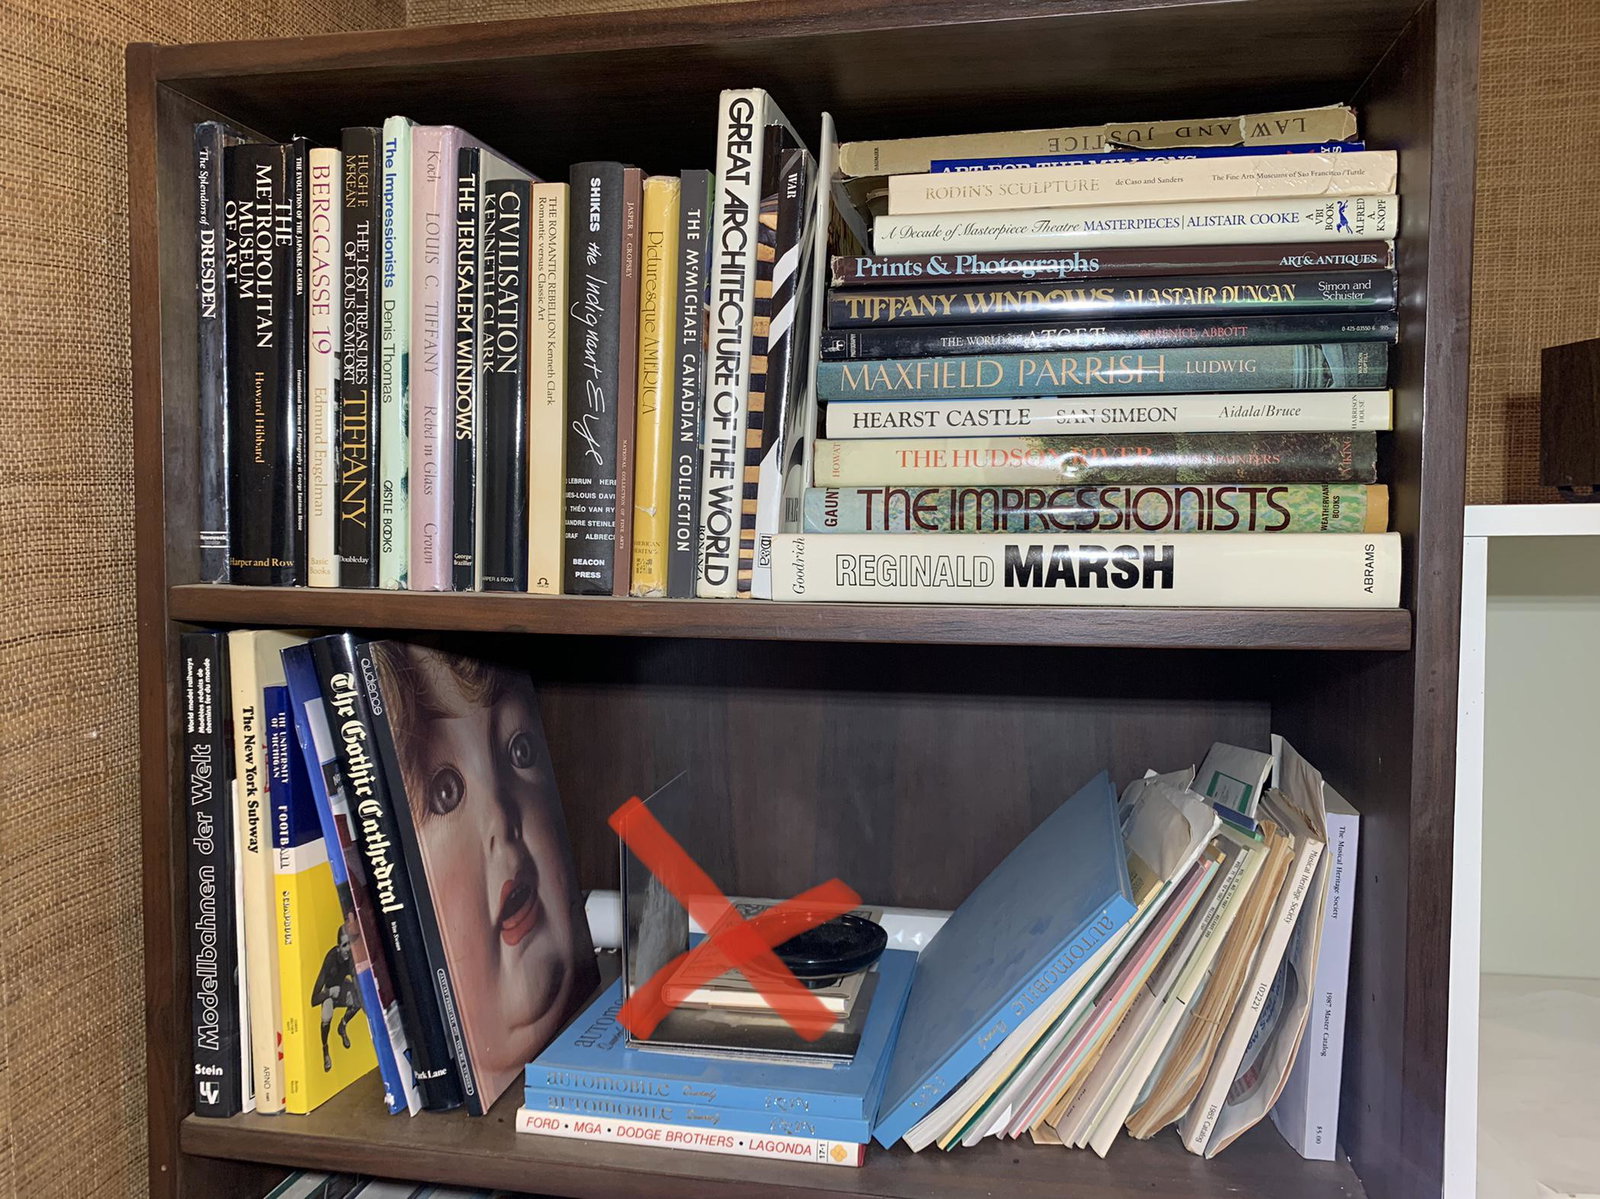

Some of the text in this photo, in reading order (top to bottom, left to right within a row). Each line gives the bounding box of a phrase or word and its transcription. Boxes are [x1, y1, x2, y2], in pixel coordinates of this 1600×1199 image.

[1250, 117, 1306, 138] LAW
[358, 154, 368, 190] HUGH
[787, 173, 798, 199] WAR
[1000, 179, 1100, 196] SCULPTURE
[1158, 176, 1183, 184] Sanders
[1257, 171, 1287, 179] Museums
[198, 150, 216, 319] The Splendors of DRESDEN
[275, 199, 292, 246] THE
[296, 210, 302, 219] OF
[538, 197, 546, 240] Romantic
[587, 177, 601, 266] SHIKES the
[1251, 213, 1299, 225] COOKE
[1325, 203, 1334, 230] BOOK
[1356, 198, 1365, 234] ALFRED
[1377, 199, 1386, 231] KNOPF
[225, 200, 237, 283] OF ART
[239, 201, 254, 298] MUSEUM
[256, 165, 272, 348] METROPOLITAN
[625, 243, 633, 278] CROPSEY
[383, 138, 397, 403] The Impressionists Denis Thomas
[497, 191, 520, 374] CIVILISATION
[855, 252, 1377, 278] Prints & Photographs ANTIQUES
[1318, 280, 1371, 291] Simon and
[356, 220, 369, 384] THE TREASURES
[456, 173, 476, 440] THE JERUSALEM WINDOWS
[538, 273, 546, 304] Classic
[547, 197, 557, 406] THE ROMANTIC REBELLION Kenneth Clark
[845, 284, 1296, 321] TIFFANY WINDOWS DUNCAN
[1322, 291, 1364, 301] Schuster
[344, 241, 355, 384] OF LOUIS COMFORT
[538, 306, 546, 321] Art
[640, 231, 664, 415] Picturesque AMERICA
[312, 166, 332, 516] BERGGASSE 19 Edmund Engelman
[424, 150, 441, 564] Koch LOUIS TIFFANY Rebel in Glass Crown
[704, 98, 753, 586] GREAT ARCHITECTURE OF THE WORLD
[940, 326, 1248, 346] THE ABBOTT
[677, 209, 700, 551] THE CANADIAN COLLECTION
[840, 355, 1256, 391] MAXFIELD PARRISH LUDWIG
[255, 372, 265, 463] Howard Hibbard
[852, 407, 1178, 428] HEARST CASTLE SAN SIMEON
[342, 390, 367, 528] TIFFANY
[832, 444, 840, 478] HOWAT
[896, 447, 1058, 469] THE HUDSON
[383, 480, 392, 553] CASTLE BOOKS
[950, 486, 1291, 531] IMPRESSIONISTS
[1332, 495, 1340, 518] BOOKS
[254, 558, 294, 566] and Row
[697, 525, 705, 581] BONANZA
[792, 536, 805, 594] Goodrich
[836, 545, 1174, 589] REGINALD MARSH
[1364, 544, 1375, 593] ABRAMS
[330, 672, 374, 797] The Gothic
[243, 706, 259, 853] The New York Subway
[280, 732, 288, 784] UNIVERSITY
[278, 806, 290, 870] FOOTBALL
[1336, 841, 1344, 866] Musical
[191, 745, 219, 1050] Modellbahnen der Welt
[1333, 868, 1343, 896] Heritage
[1331, 898, 1341, 919] Society
[1321, 1035, 1329, 1056] Catalog
[195, 1064, 223, 1075] Stein
[526, 1117, 812, 1156] FORD MGA DODGE BROTHERS LAGONDA
